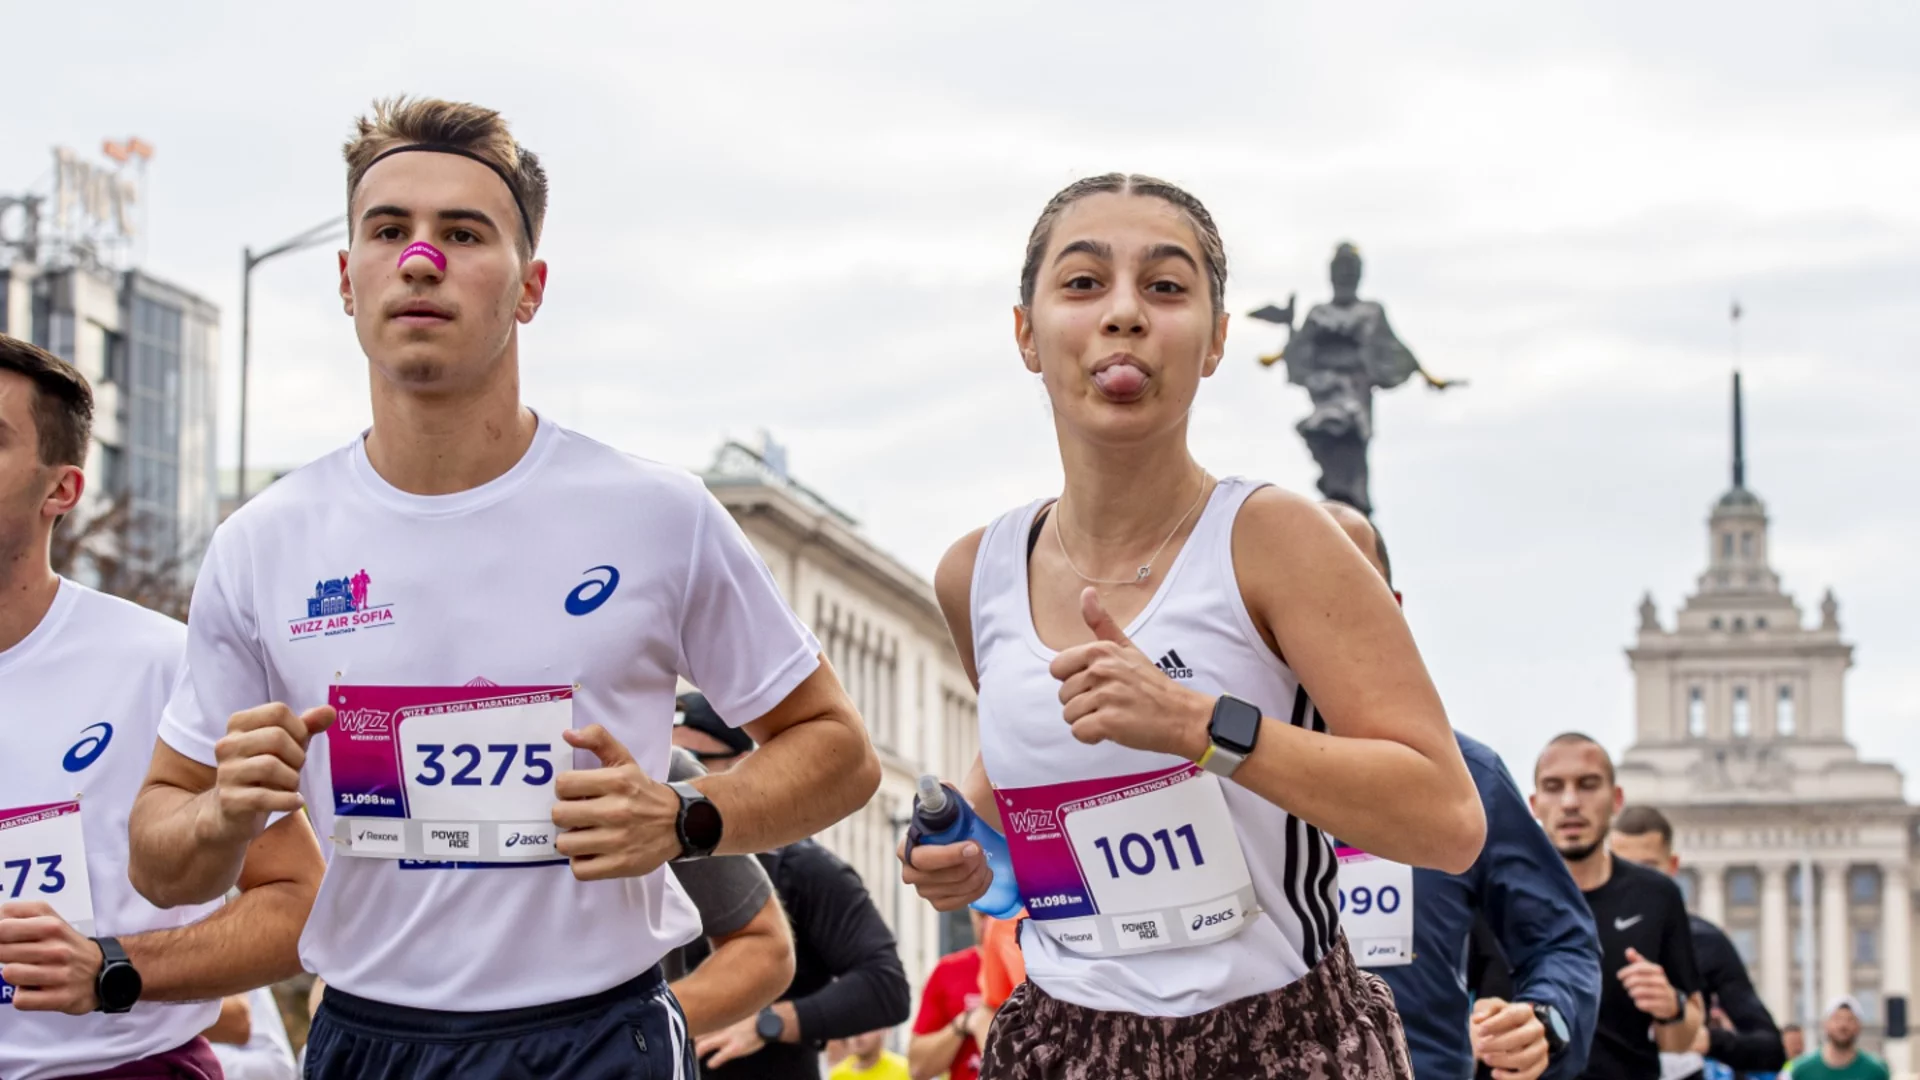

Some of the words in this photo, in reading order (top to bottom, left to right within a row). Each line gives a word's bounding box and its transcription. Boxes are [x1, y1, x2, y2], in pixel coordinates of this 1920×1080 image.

[290, 619, 323, 635] WIZZ
[327, 616, 349, 629] AIR
[352, 608, 393, 625] SOFIA
[401, 708, 426, 718] WIZZ
[428, 706, 444, 715] AIR
[446, 703, 475, 713] SOFIA
[477, 697, 528, 709] MARATHON
[530, 694, 551, 704] 2025
[415, 743, 553, 786] 3275
[1062, 802, 1083, 813] WIZZ
[1084, 799, 1099, 810] AIR
[1100, 793, 1122, 806] SOFIA
[1123, 779, 1168, 799] MARATHON
[1169, 770, 1192, 786] 2025
[341, 793, 380, 805] 21.098
[380, 796, 396, 806] km
[0, 814, 40, 830] ARATHON
[366, 831, 399, 842] Rexona
[431, 830, 470, 840] POWER
[519, 833, 549, 846] asics
[448, 839, 470, 849] ADE
[1094, 823, 1205, 879] 1011
[0, 854, 66, 898] 73
[1030, 894, 1067, 908] 21.098
[1067, 895, 1082, 904] km
[1204, 907, 1235, 927] asics
[1121, 920, 1157, 933] POWER
[1065, 932, 1093, 942] Rexona
